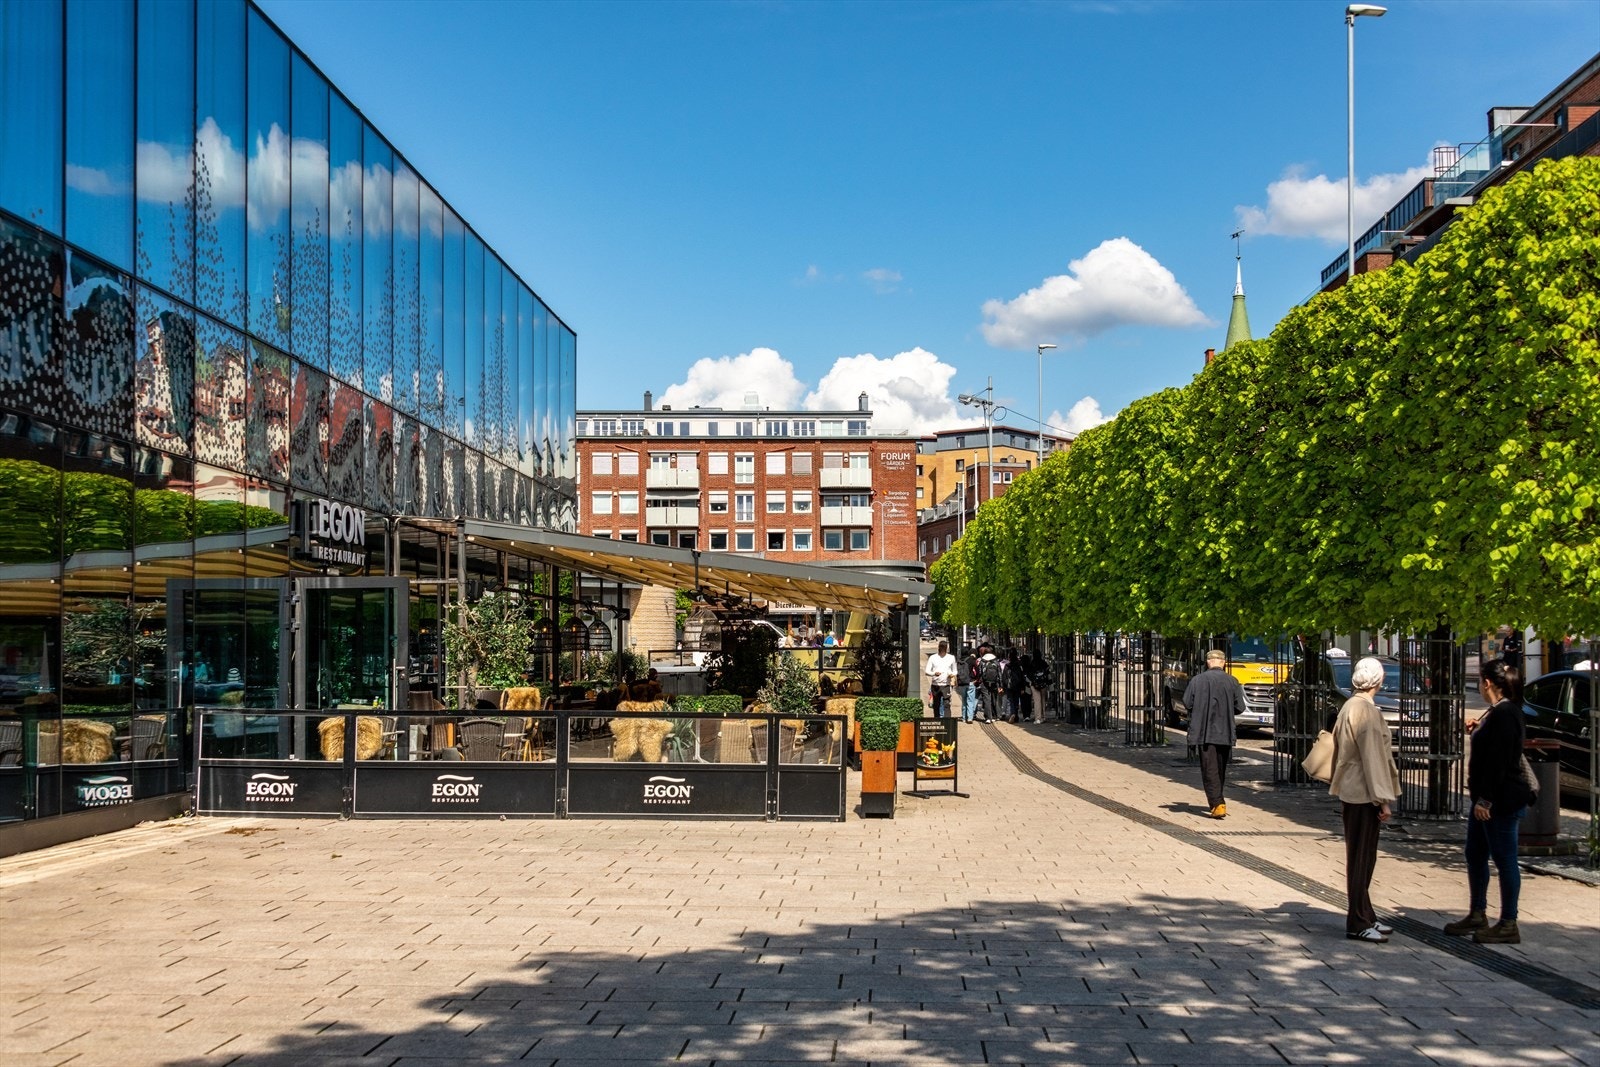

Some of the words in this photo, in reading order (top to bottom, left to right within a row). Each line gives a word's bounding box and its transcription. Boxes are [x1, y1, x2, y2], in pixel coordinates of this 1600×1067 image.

[318, 498, 366, 546] EGON
[318, 546, 366, 566] RESTAURANT
[246, 782, 295, 796] EGON
[432, 784, 480, 796] EGON
[644, 784, 691, 798] EGON
